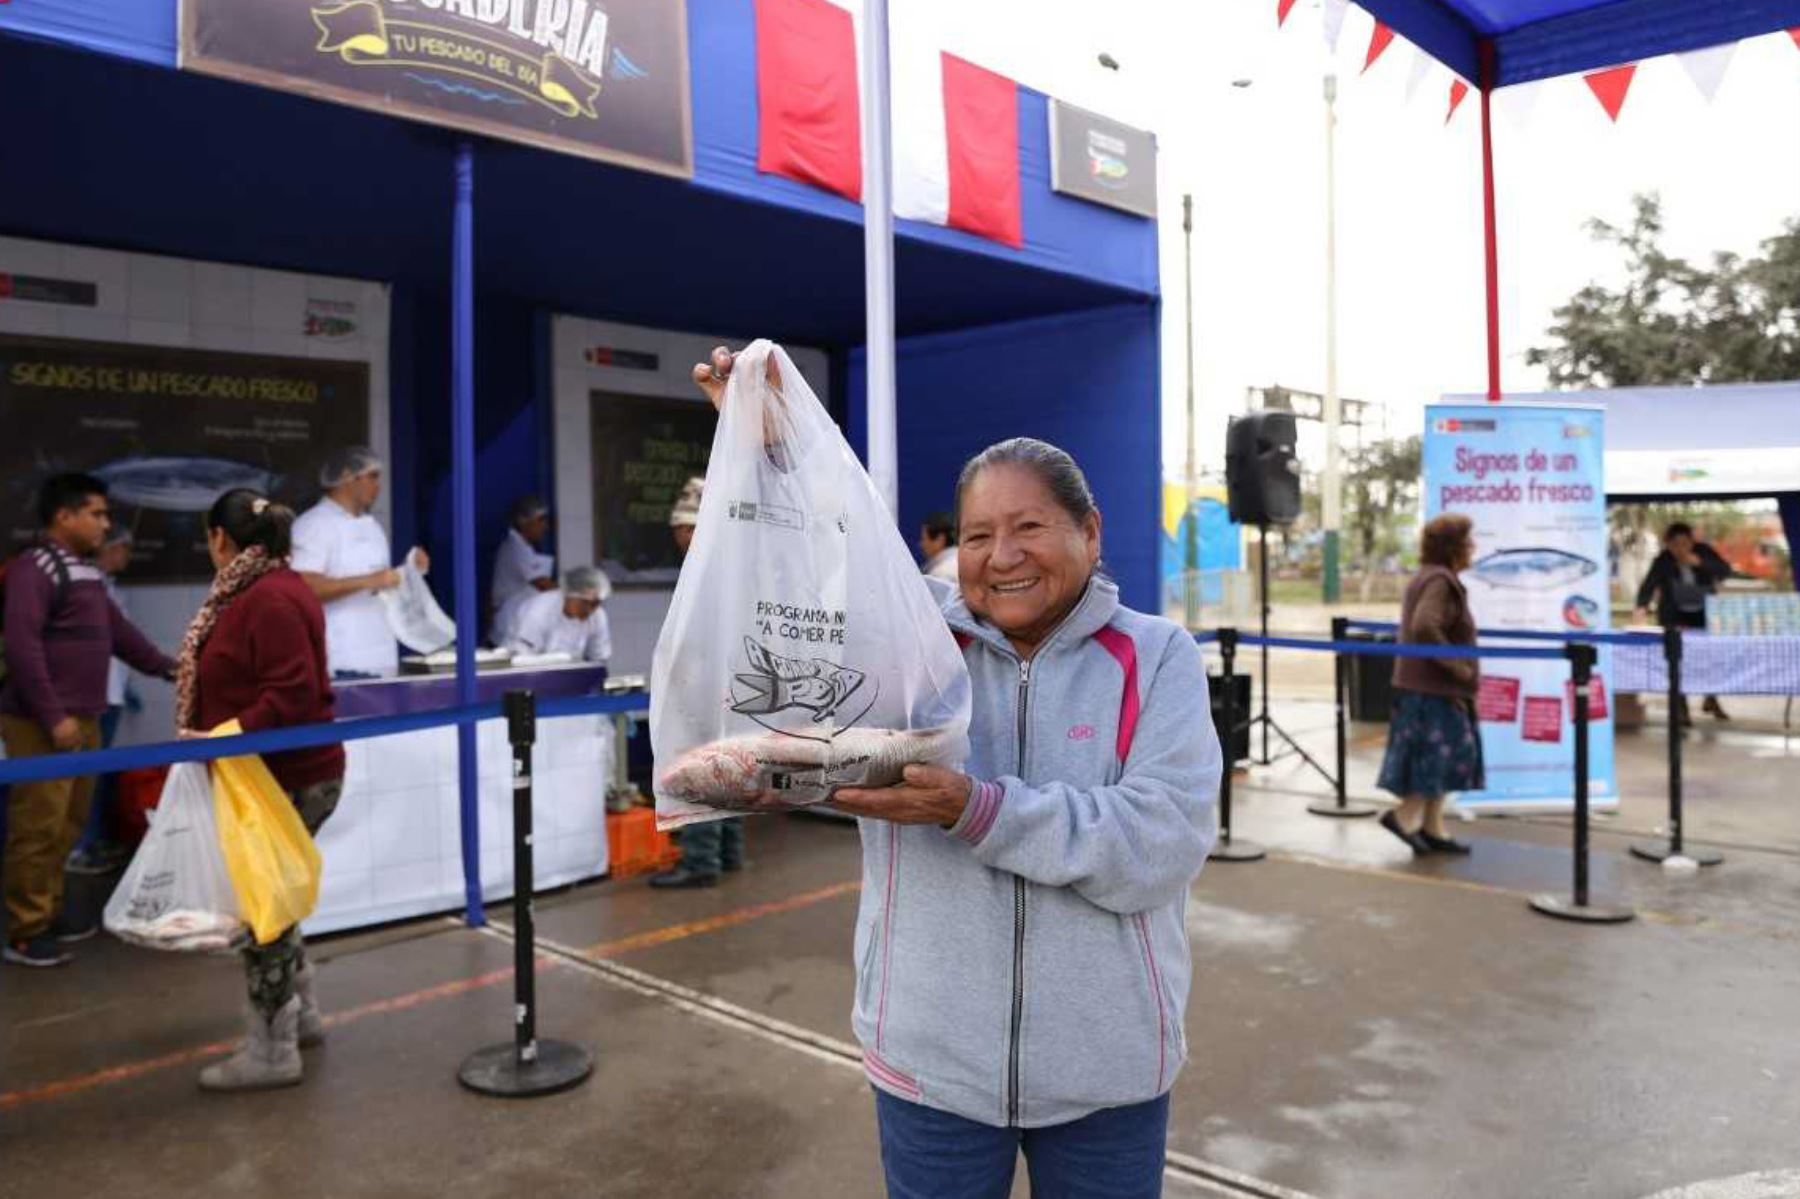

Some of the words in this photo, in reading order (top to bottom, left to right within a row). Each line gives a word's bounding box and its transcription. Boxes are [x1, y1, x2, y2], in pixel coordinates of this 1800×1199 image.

[391, 34, 416, 52] TU
[419, 36, 486, 66] PESCADO
[488, 53, 514, 77] DEL
[8, 362, 93, 390] SIGNOS
[96, 366, 126, 393] DE
[127, 369, 159, 394] UN
[160, 371, 248, 400] PESCADO
[249, 376, 319, 404] FRESCO
[1456, 444, 1519, 479] Signos
[1524, 449, 1547, 471] de
[1553, 453, 1578, 472] un
[1441, 479, 1521, 511] pescado
[1527, 477, 1594, 502] fresco
[757, 600, 829, 624] PROGRAMA
[780, 623, 824, 642] COMER
